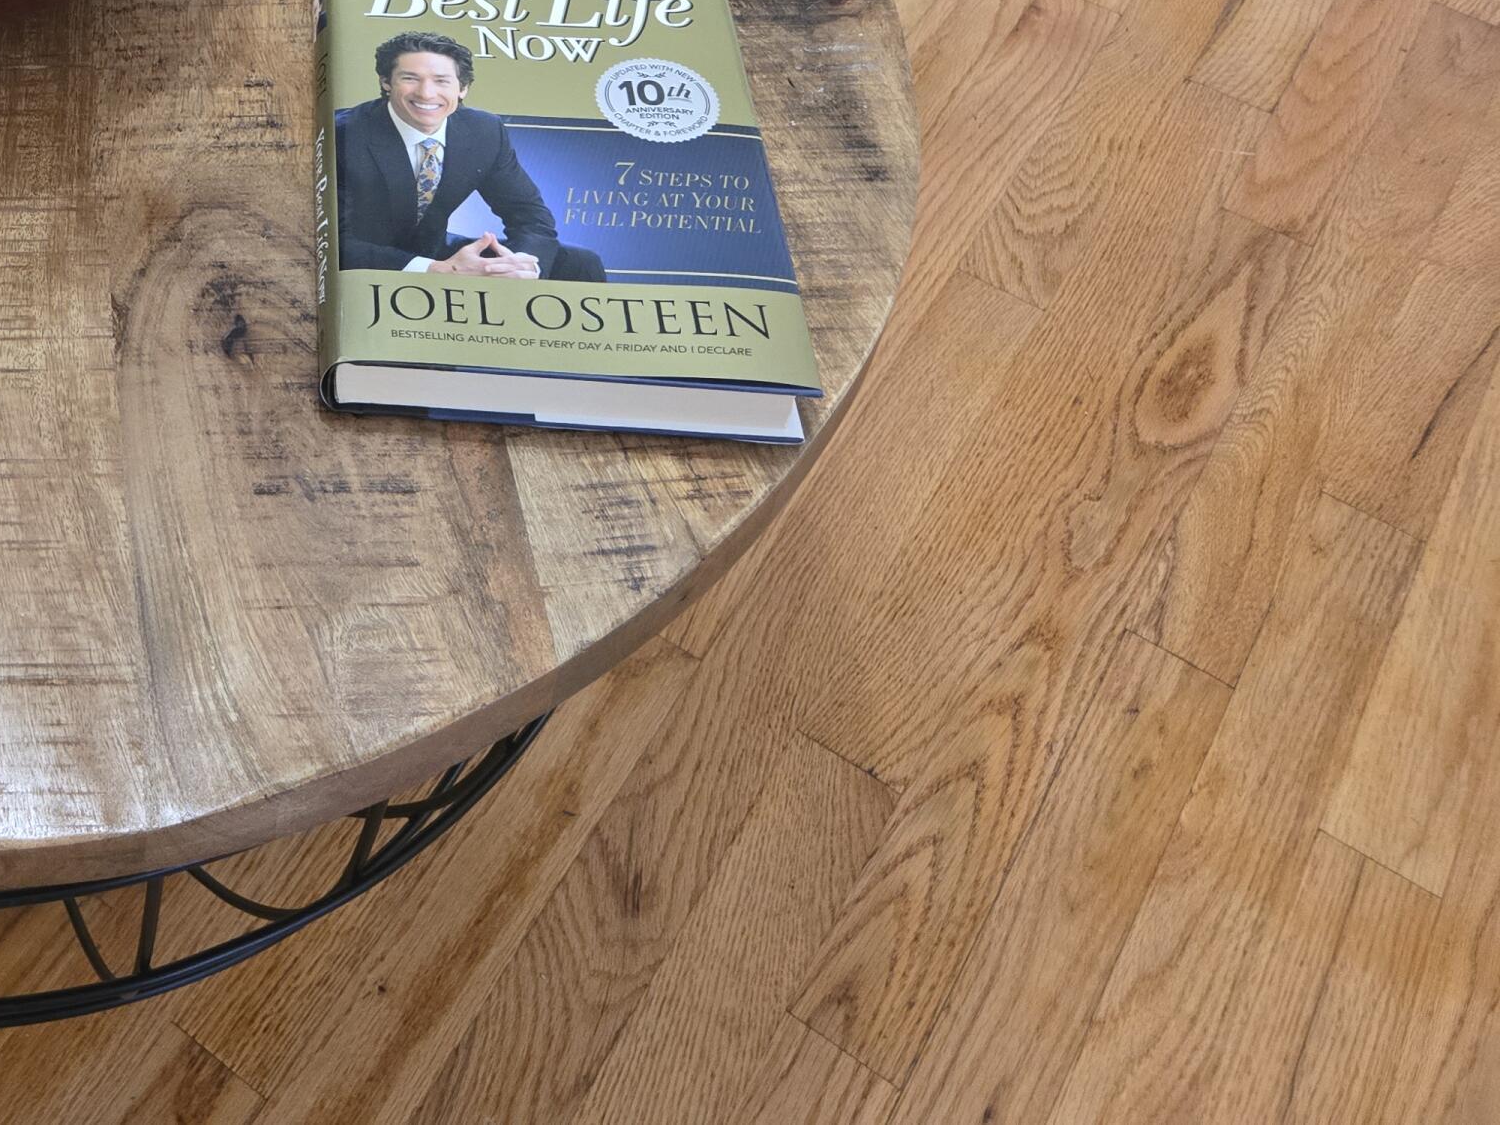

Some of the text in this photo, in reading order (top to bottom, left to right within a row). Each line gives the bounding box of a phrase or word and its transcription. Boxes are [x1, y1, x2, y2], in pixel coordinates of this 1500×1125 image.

[471, 25, 605, 63] NOW
[610, 63, 697, 83] UPDATED WITH NEW
[625, 106, 694, 116] ANNIVERSARY
[639, 113, 680, 121] EDITION
[613, 112, 652, 135] CHAPTER
[663, 115, 709, 137] FOREWORD
[614, 161, 750, 192] 7 STEPS TO
[566, 187, 756, 213] LIVING AT YOUR
[564, 208, 762, 235] FULL POTENTIAL
[367, 284, 770, 340] JOEL OSTEEN
[391, 329, 465, 342] BESTSELLING
[467, 335, 516, 346] AUTHOR
[519, 338, 537, 347] OF
[540, 339, 575, 350] EVERY
[577, 341, 602, 351] DAY
[604, 343, 612, 351] A
[616, 343, 657, 353] FRIDAY
[660, 345, 687, 354] AND
[697, 346, 752, 356] DECLARE
